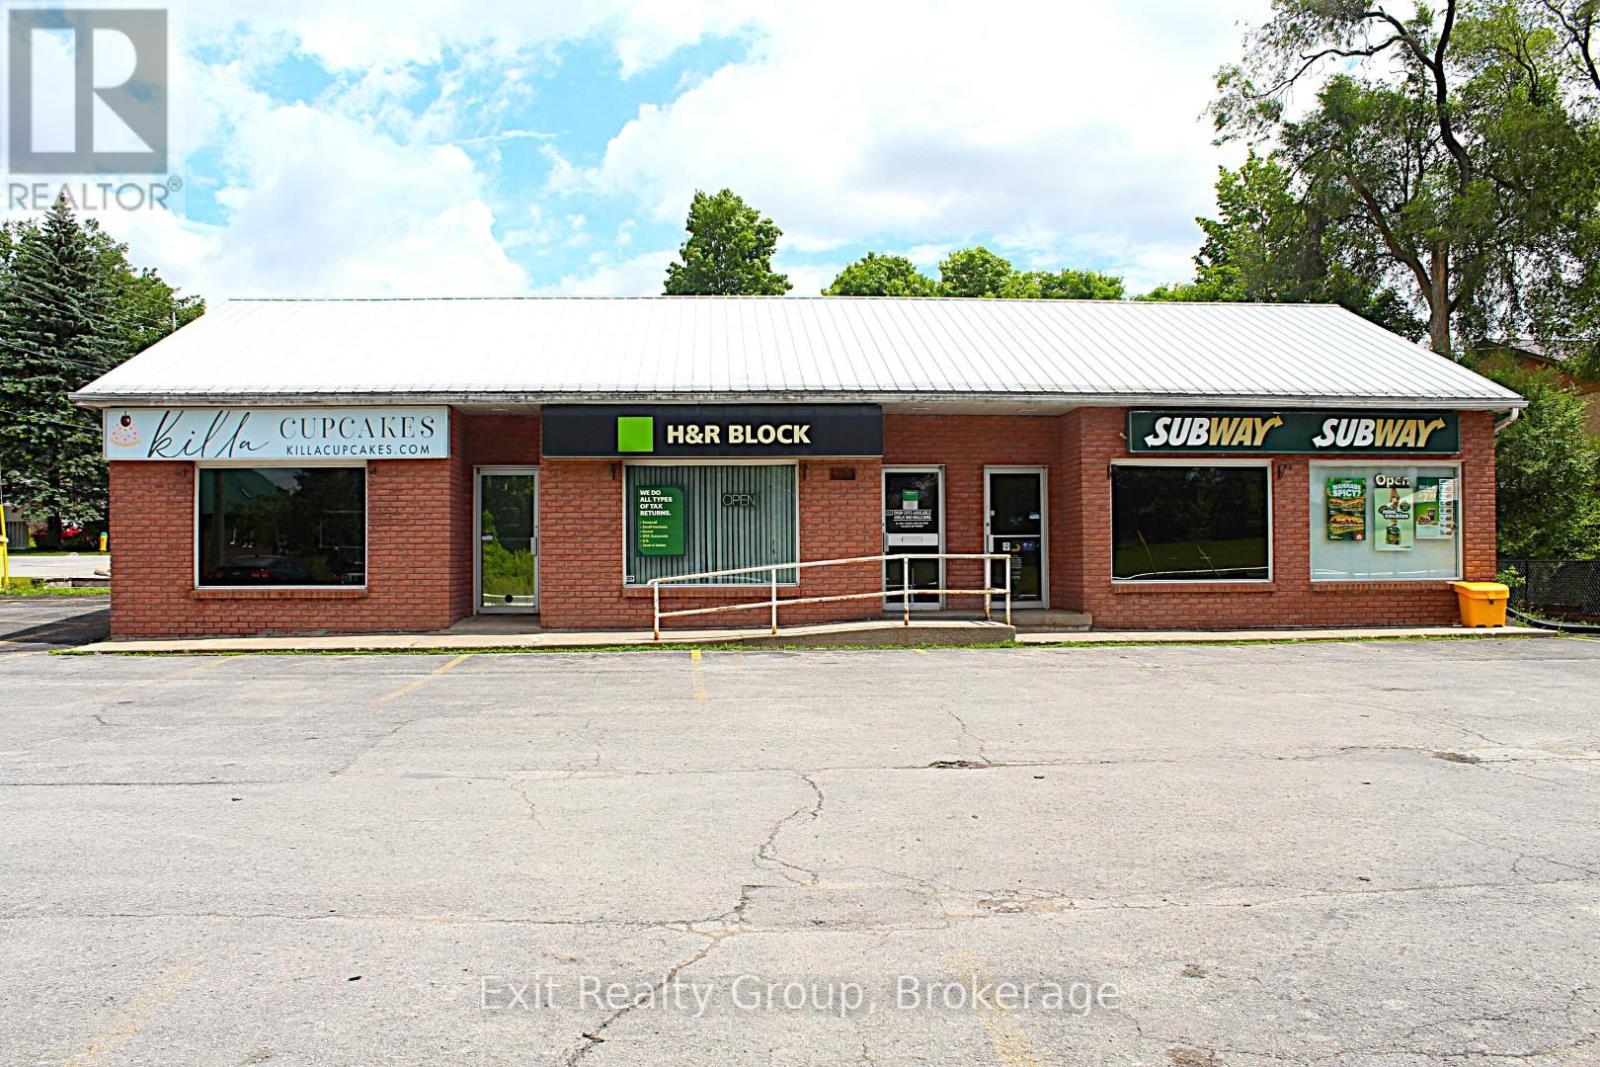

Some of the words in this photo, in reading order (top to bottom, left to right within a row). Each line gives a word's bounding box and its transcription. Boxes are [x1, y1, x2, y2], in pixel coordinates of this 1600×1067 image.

[147, 410, 269, 458] killa
[279, 416, 435, 440] CUPCAKES
[667, 424, 721, 444] H&R
[728, 424, 811, 444] BLOCK
[1144, 416, 1283, 447] SUBWAY
[1312, 417, 1445, 447] SUBWAY
[286, 444, 430, 456] KILLACUPCAKES.COM
[1375, 475, 1410, 488] Open
[723, 494, 756, 506] OPEN
